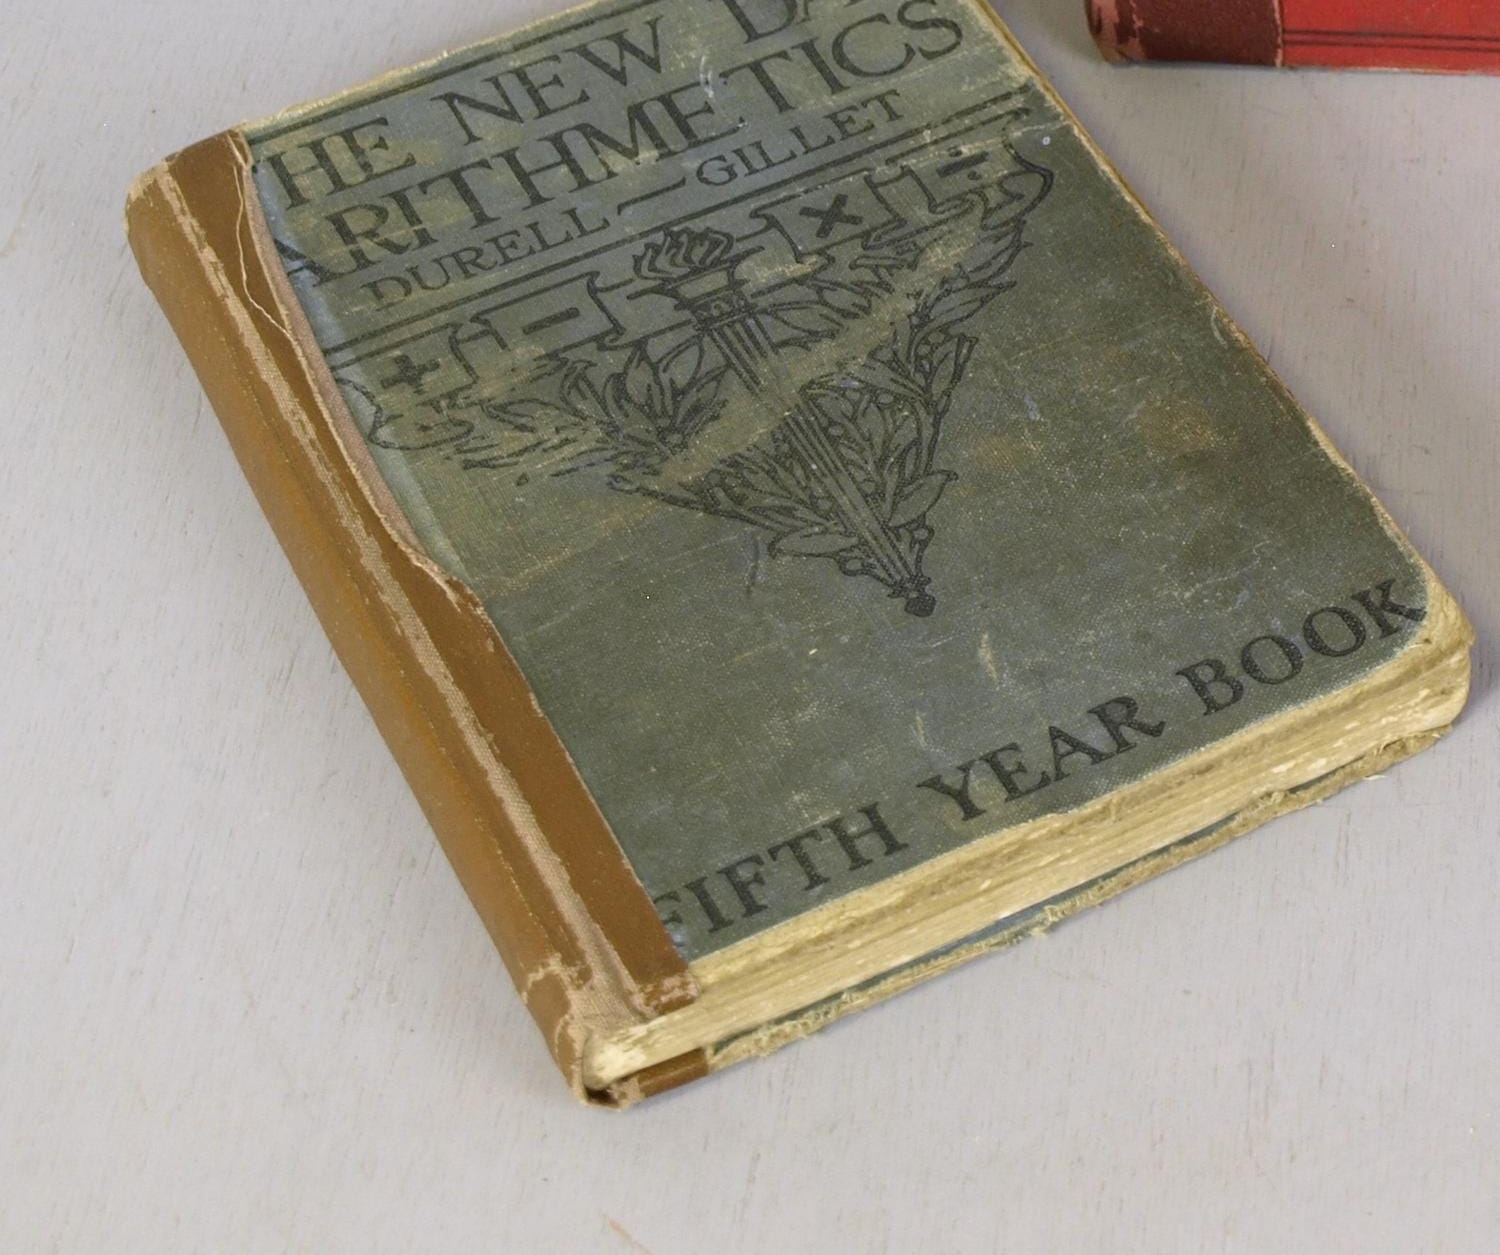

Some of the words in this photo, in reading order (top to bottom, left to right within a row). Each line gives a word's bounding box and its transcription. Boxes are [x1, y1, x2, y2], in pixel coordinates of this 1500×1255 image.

[252, 116, 416, 211] HE
[432, 17, 663, 145] NEW
[917, 694, 1166, 823] YEAR
[1176, 578, 1427, 717] BOOK
